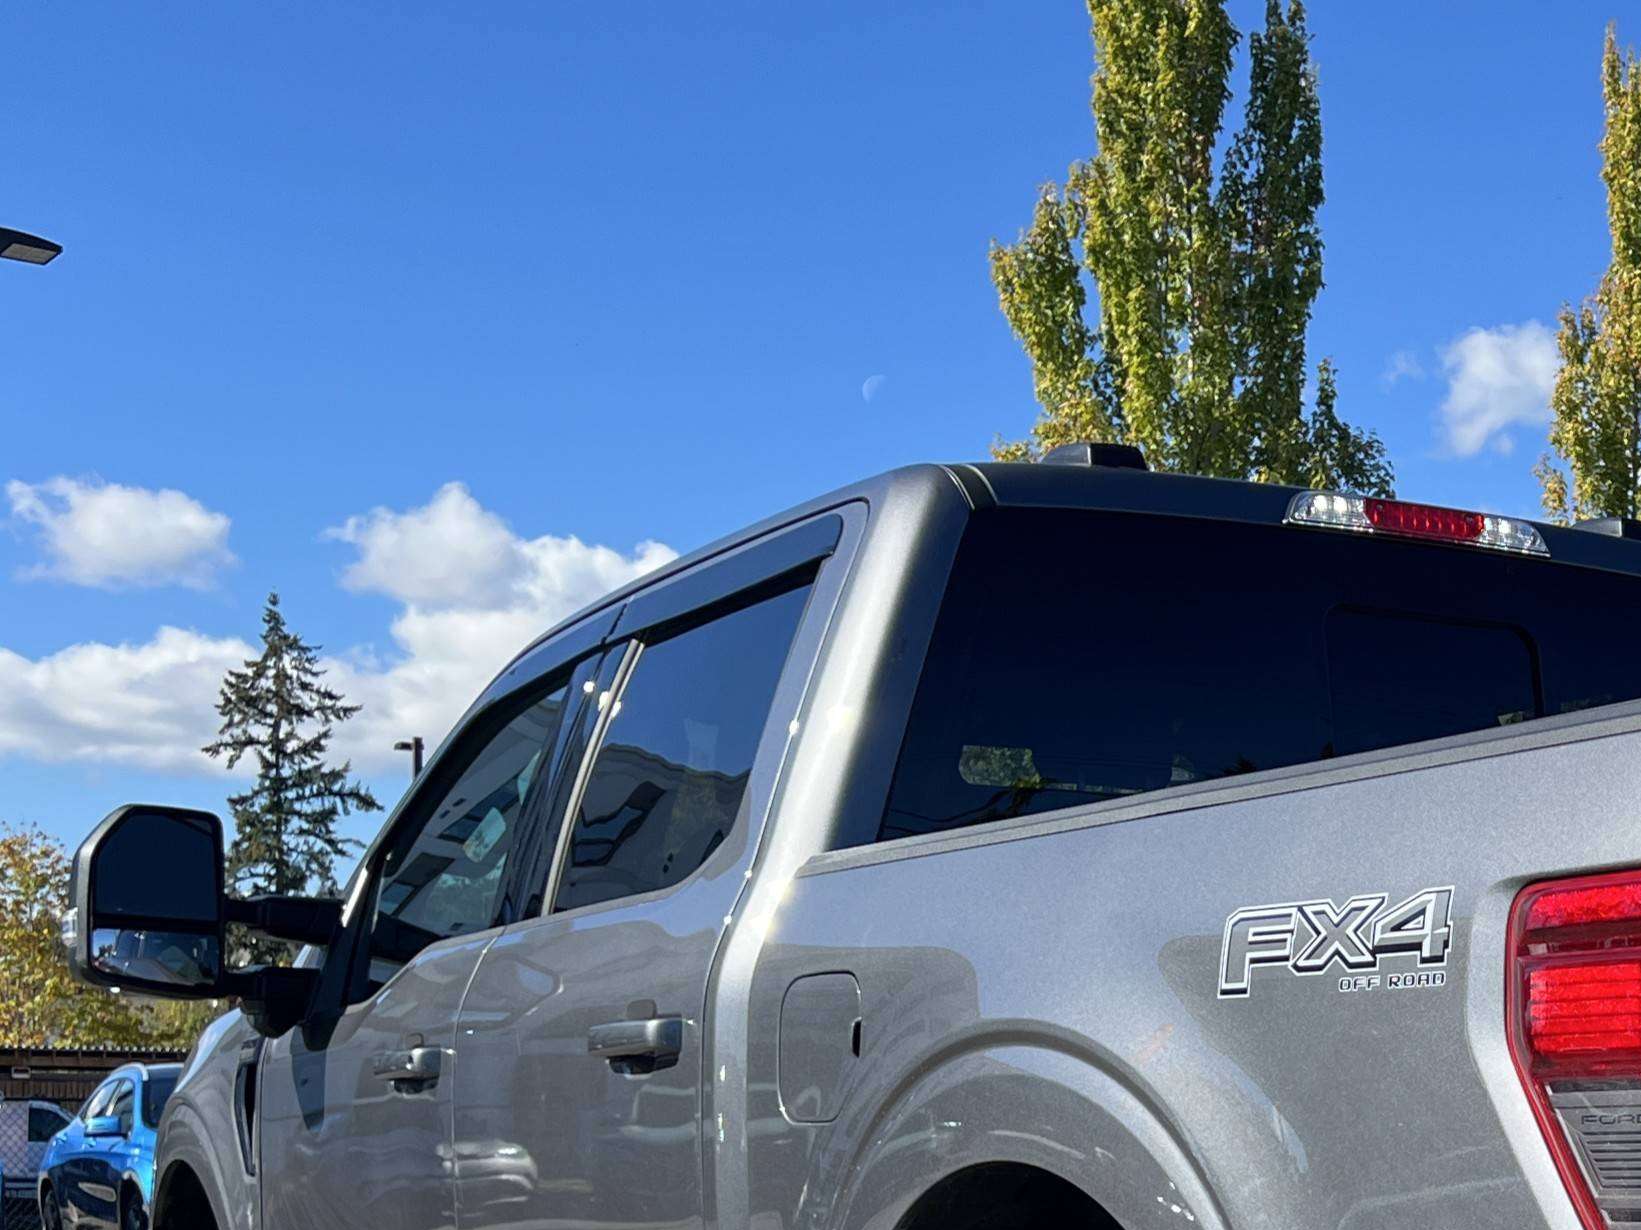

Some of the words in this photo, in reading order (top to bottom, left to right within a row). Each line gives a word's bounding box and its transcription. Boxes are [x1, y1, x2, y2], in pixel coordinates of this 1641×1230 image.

[1217, 885, 1455, 999] FX4
[1339, 974, 1380, 993] OFF
[1388, 971, 1446, 989] ROAD
